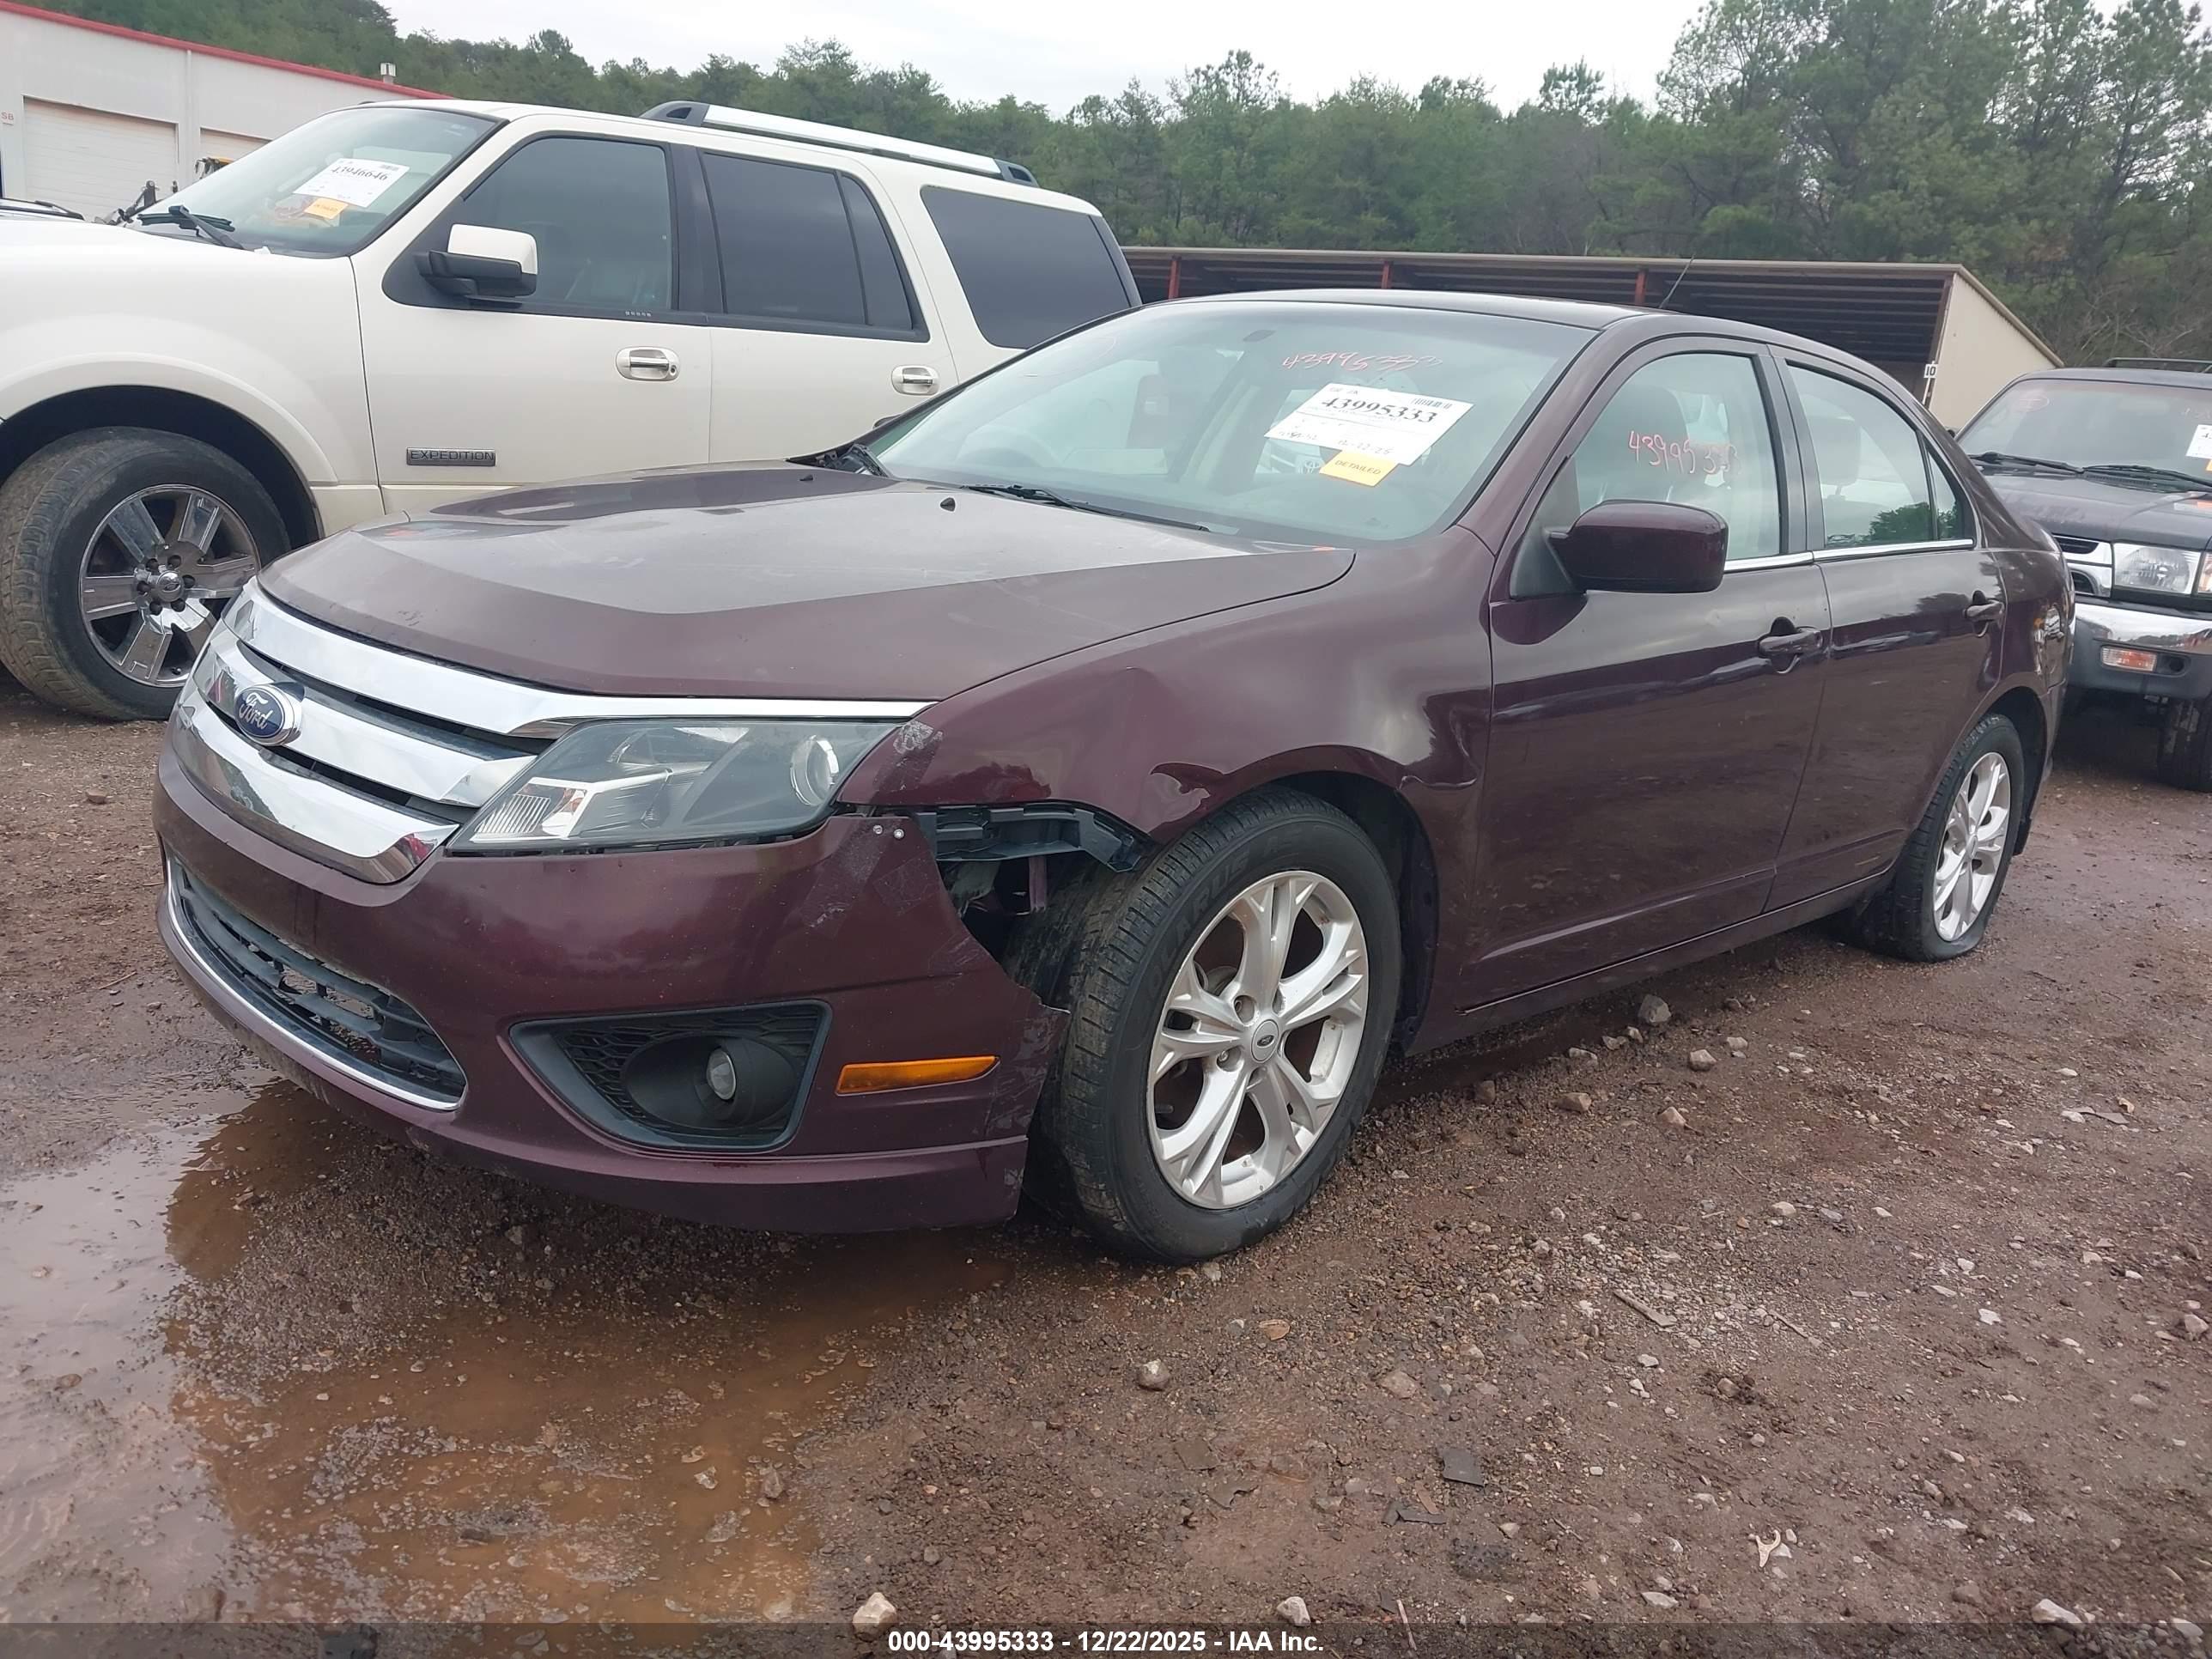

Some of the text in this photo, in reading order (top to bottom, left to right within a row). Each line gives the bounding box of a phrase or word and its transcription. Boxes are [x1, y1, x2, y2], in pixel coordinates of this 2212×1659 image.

[1925, 366, 1936, 376] 10
[1322, 398, 1437, 422] 43995333
[410, 450, 495, 461] EXPEDITION
[239, 691, 276, 730] Ford
